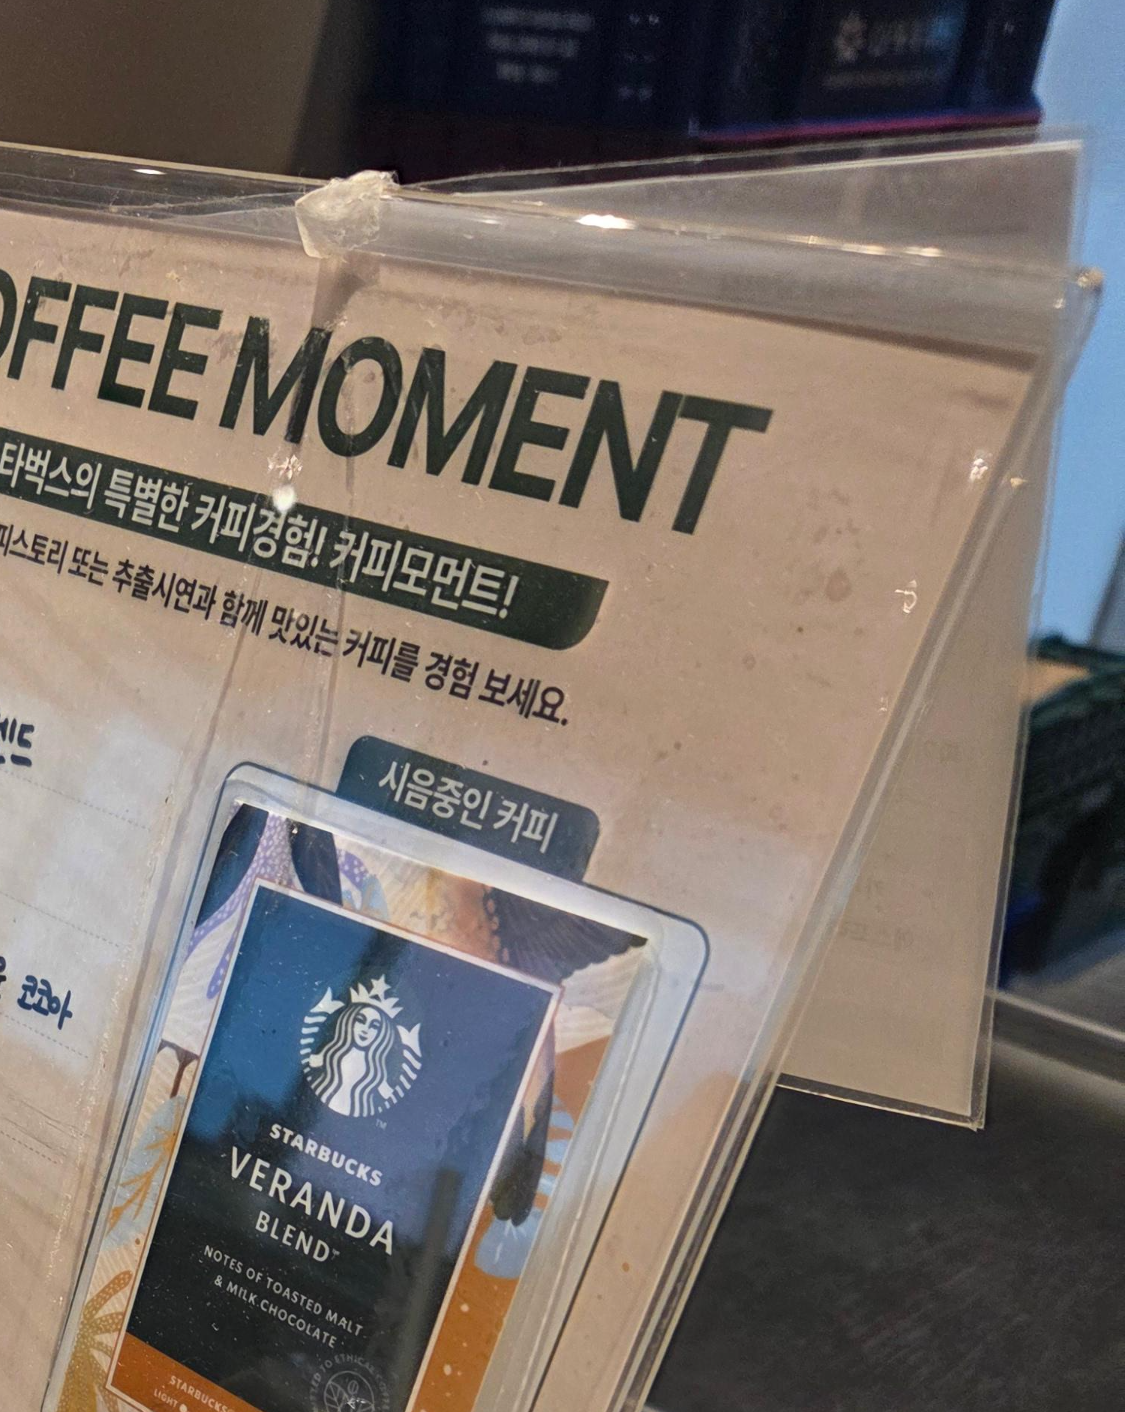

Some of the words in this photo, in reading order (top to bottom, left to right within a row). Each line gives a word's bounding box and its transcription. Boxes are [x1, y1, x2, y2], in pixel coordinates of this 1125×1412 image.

[219, 314, 774, 535] MOMENT
[103, 468, 189, 533] 특별한
[191, 495, 328, 568] 커피경험!
[330, 531, 519, 619] 커피모먼트!
[68, 546, 108, 586] 또는
[112, 559, 217, 621] 추출시연과
[220, 591, 268, 635] 함께
[269, 606, 339, 657] 맛있는
[343, 628, 421, 682] 커피를
[425, 651, 480, 700] 경험
[479, 669, 568, 726] 보세요.
[378, 760, 493, 830] 시음중인
[493, 800, 559, 854] 커피
[230, 1146, 394, 1256] VERANDA
[269, 1123, 384, 1187] STARBUCKS
[204, 1244, 242, 1274] NOTES
[246, 1266, 263, 1283] OF
[266, 1276, 322, 1316] TOASTED
[325, 1309, 364, 1337] MALT
[214, 1275, 223, 1287] &
[226, 1280, 257, 1305] MILK
[259, 1298, 337, 1349] CHOCOLATE
[153, 1388, 178, 1408] LIGHT
